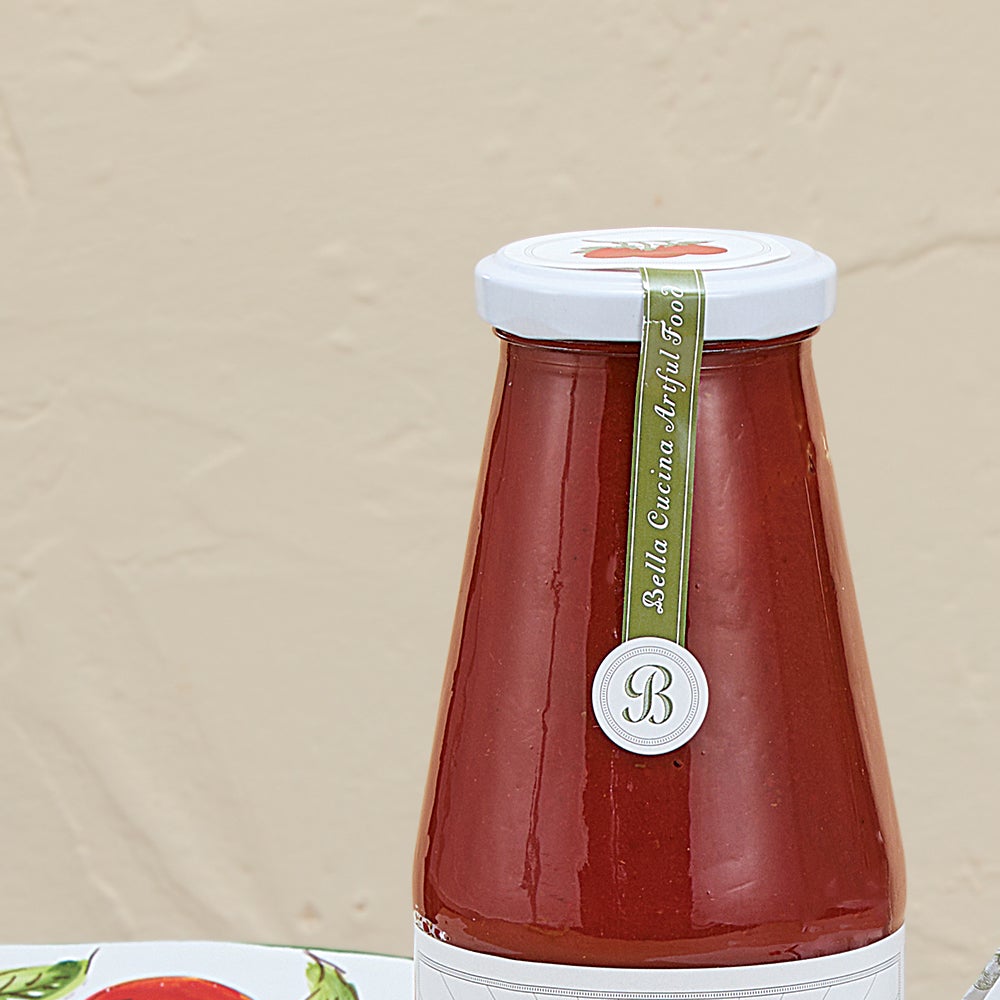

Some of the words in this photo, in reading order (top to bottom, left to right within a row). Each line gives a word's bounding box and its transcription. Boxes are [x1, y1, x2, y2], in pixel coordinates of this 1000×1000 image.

[660, 285, 684, 346] Food
[655, 350, 686, 431] Artful
[648, 440, 674, 533] Cucina
[643, 539, 668, 614] Bella
[621, 663, 674, 725] B
